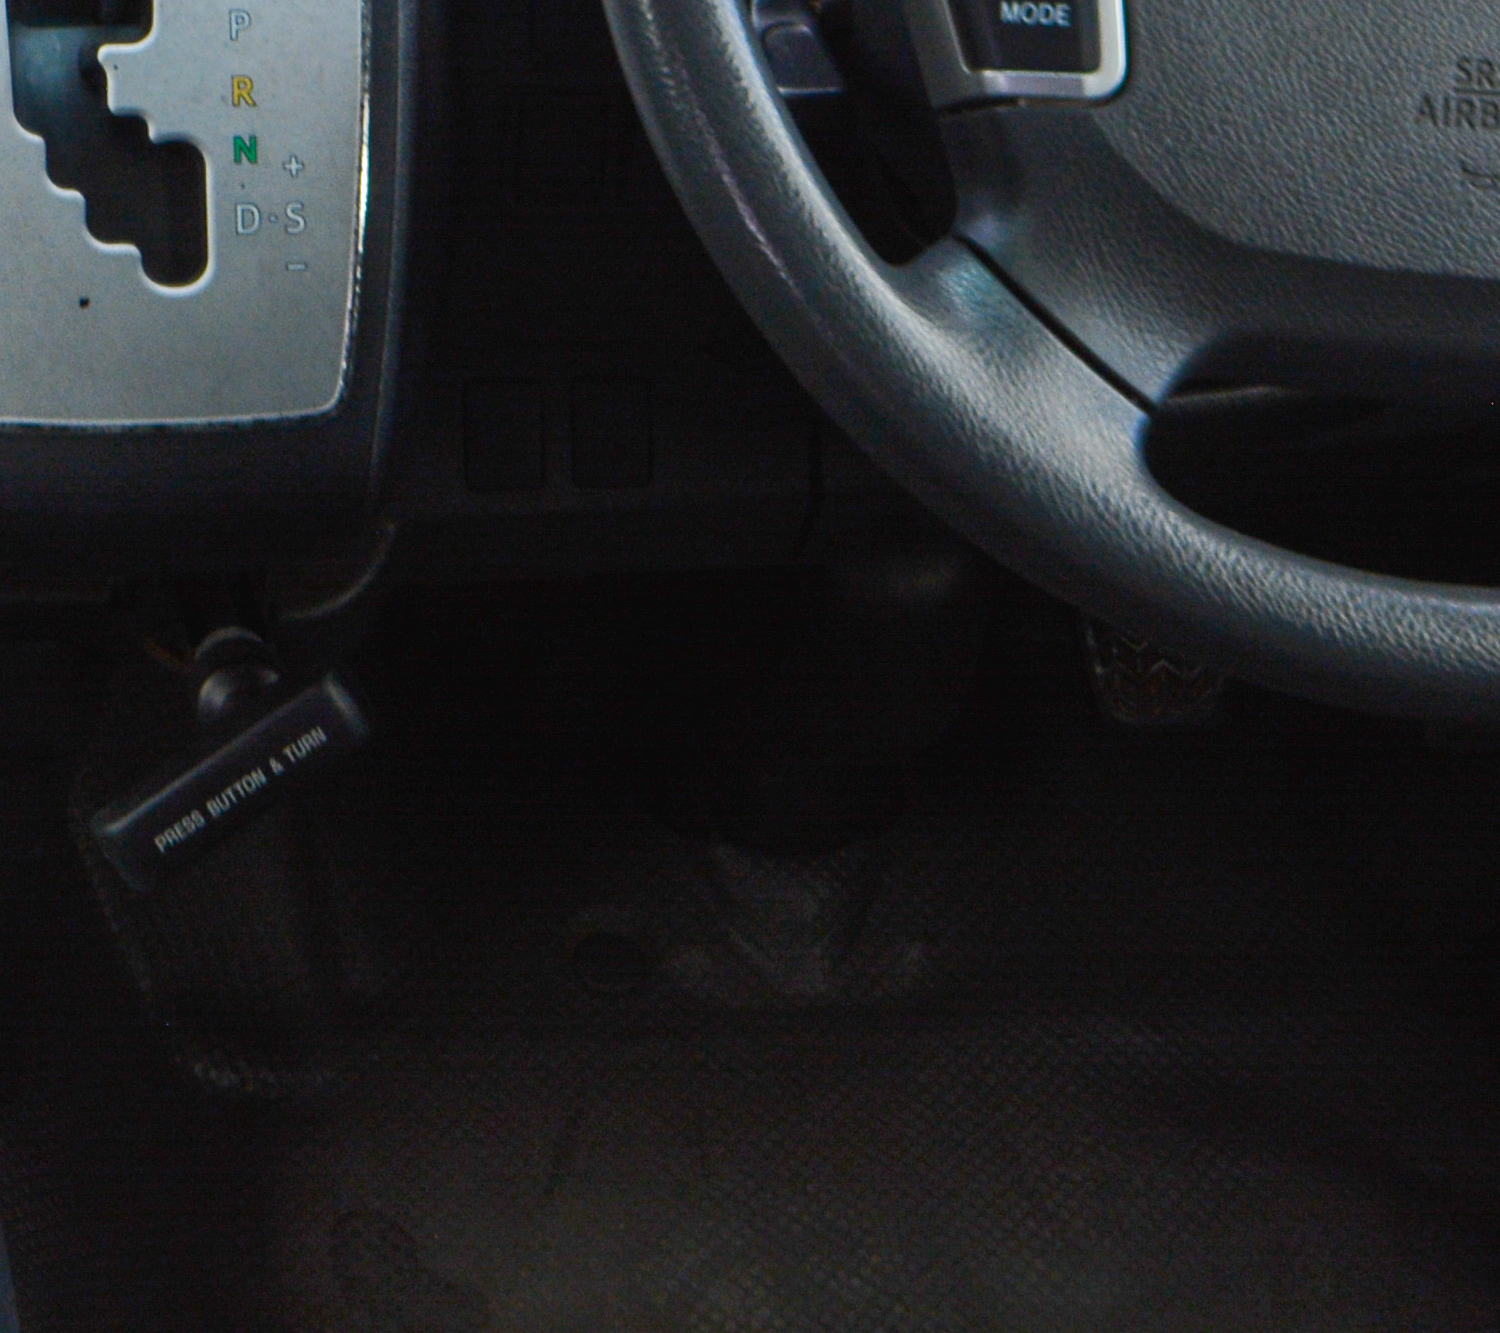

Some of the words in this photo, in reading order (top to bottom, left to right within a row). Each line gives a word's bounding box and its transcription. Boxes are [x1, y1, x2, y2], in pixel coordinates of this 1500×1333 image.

[229, 9, 253, 41] P
[1001, 1, 1071, 27] MODE
[231, 75, 256, 108] R
[232, 135, 258, 164] N
[155, 810, 206, 853] PRESS
[206, 768, 267, 817] BUTTON
[269, 757, 285, 776] &
[284, 727, 327, 762] TURN
